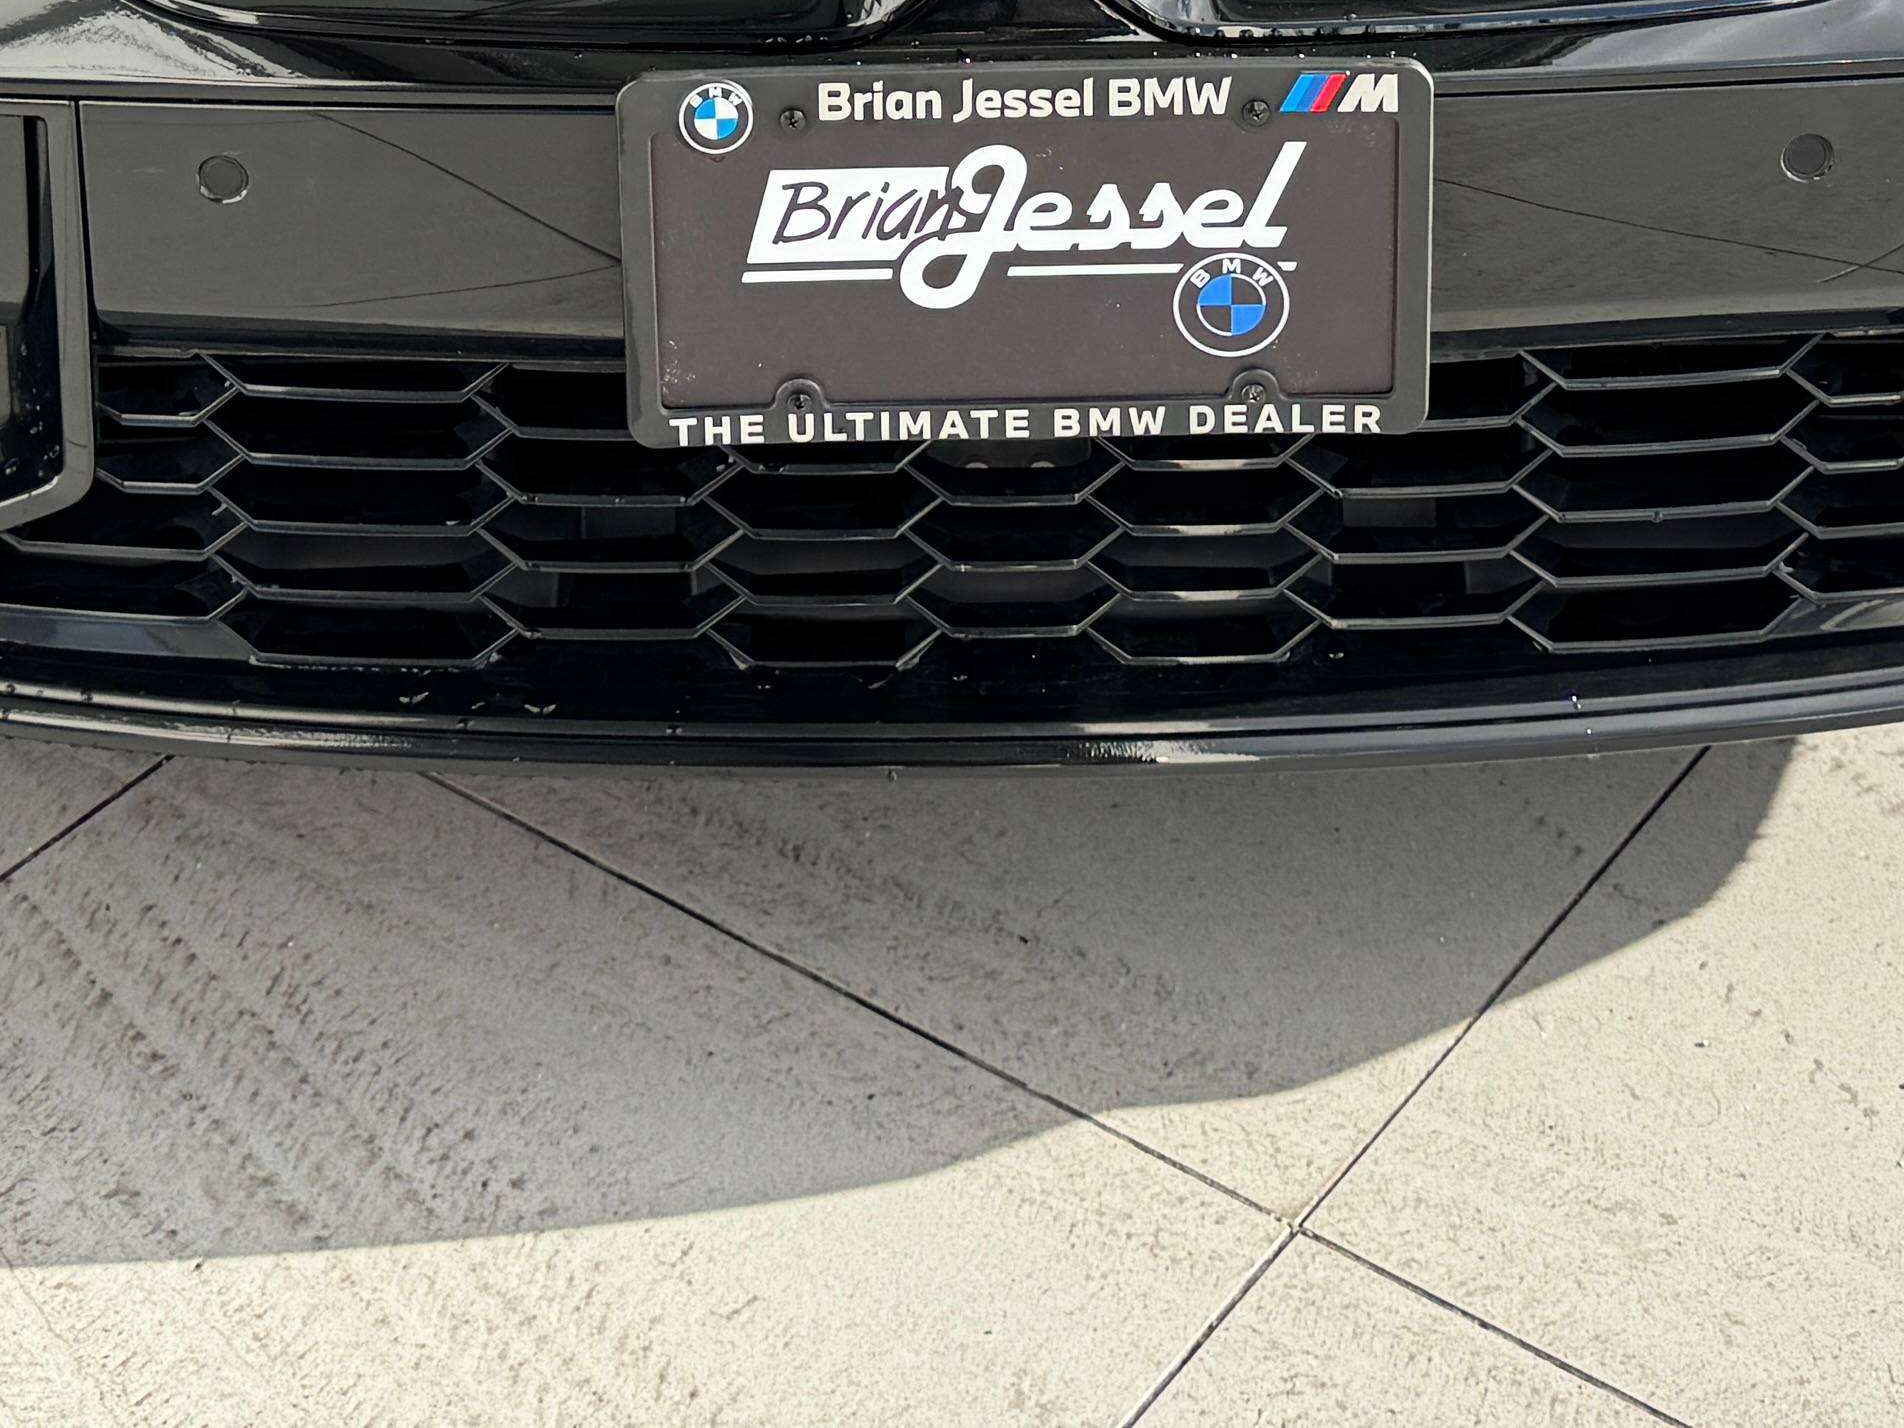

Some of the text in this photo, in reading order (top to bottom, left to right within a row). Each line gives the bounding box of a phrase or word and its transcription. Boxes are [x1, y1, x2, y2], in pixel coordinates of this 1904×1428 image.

[818, 75, 1233, 123] Brian Jessel BMW
[771, 140, 1308, 312] Brian Jessel
[1188, 257, 1275, 290] BMW
[668, 403, 1383, 447] THE ULTIMATE BMW DEALER
